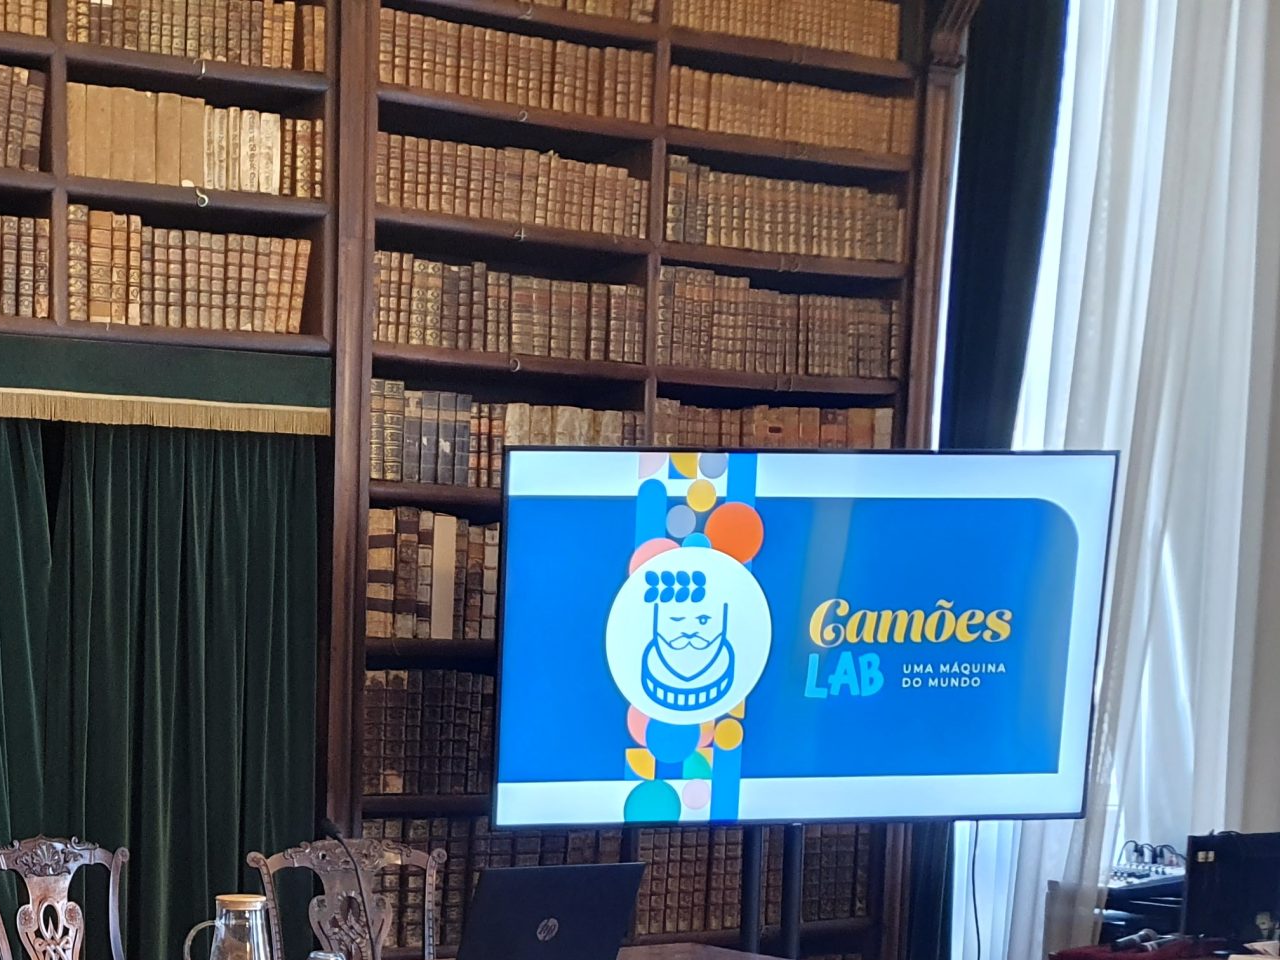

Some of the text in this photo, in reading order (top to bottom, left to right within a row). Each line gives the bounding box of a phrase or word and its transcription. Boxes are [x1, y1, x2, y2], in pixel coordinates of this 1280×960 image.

[513, 225, 528, 242] 4
[809, 598, 1013, 648] Camões
[804, 651, 885, 699] LAB
[903, 661, 1007, 675] UMA MÁQUINA
[901, 676, 982, 688] DO MUNDO
[536, 917, 559, 941] hp
